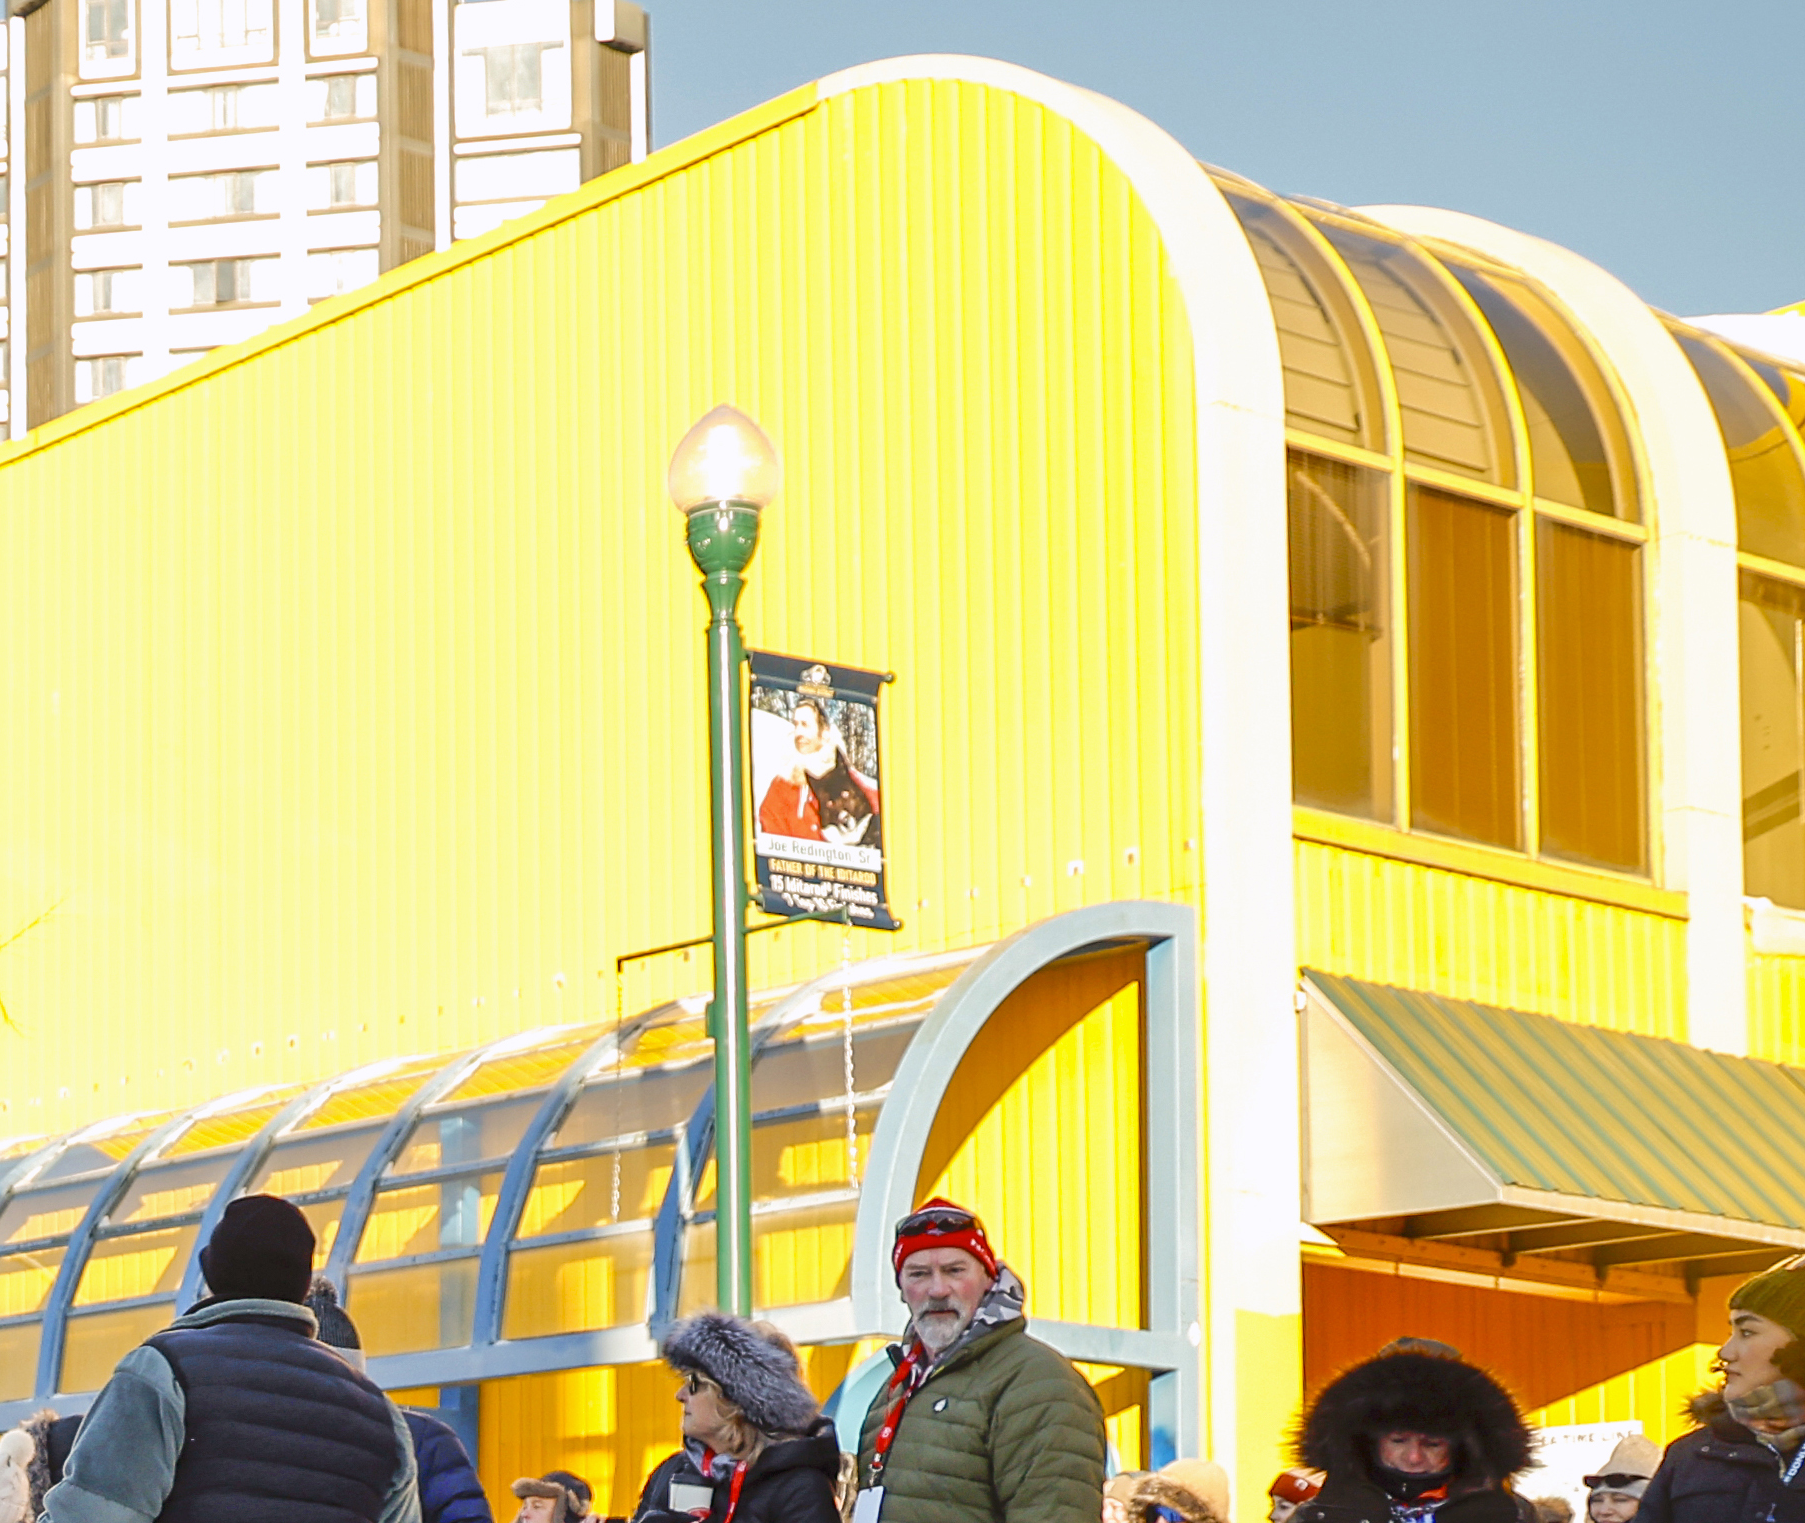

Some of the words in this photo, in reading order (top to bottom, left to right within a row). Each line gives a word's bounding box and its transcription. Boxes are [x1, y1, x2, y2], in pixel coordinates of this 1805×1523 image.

[769, 838, 788, 852] Joe
[769, 858, 803, 877] FATHER
[804, 863, 817, 878] OF
[818, 865, 836, 881] THE
